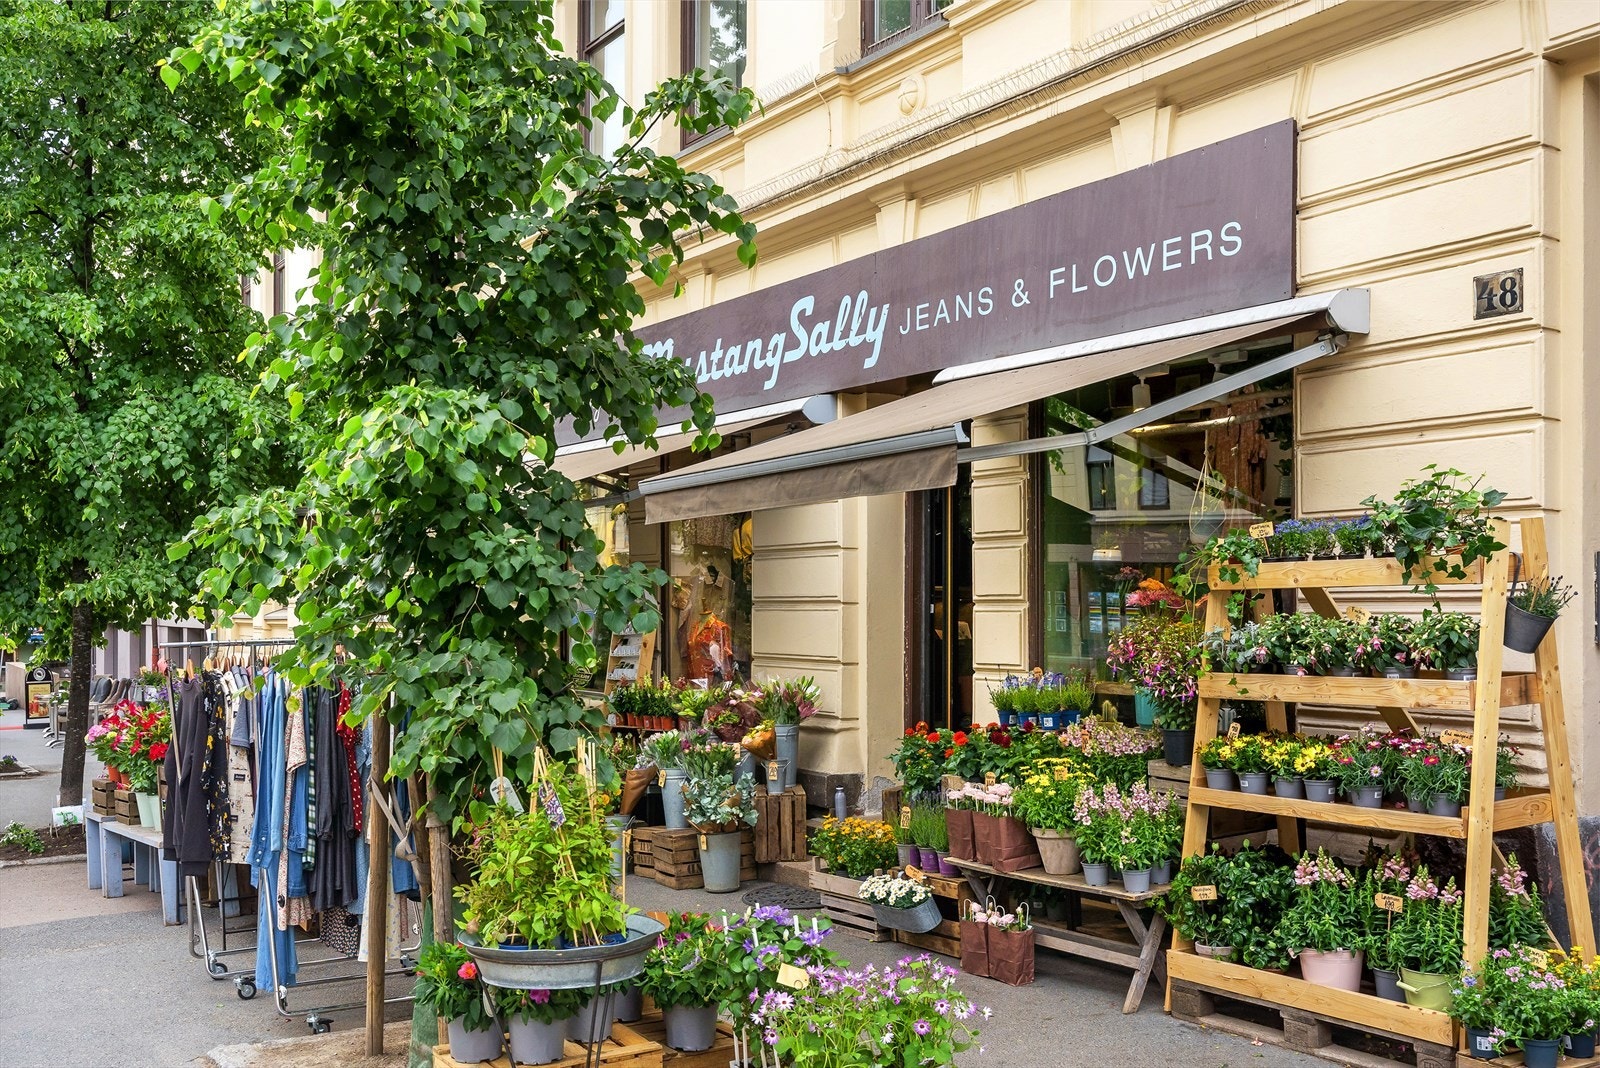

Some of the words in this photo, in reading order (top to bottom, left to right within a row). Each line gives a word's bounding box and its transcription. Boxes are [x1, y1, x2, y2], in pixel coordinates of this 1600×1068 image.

[641, 333, 787, 391] stang
[899, 286, 993, 335] JEANS
[1011, 278, 1030, 308] &
[1049, 221, 1243, 299] FLOWERS
[1477, 276, 1518, 311] 48
